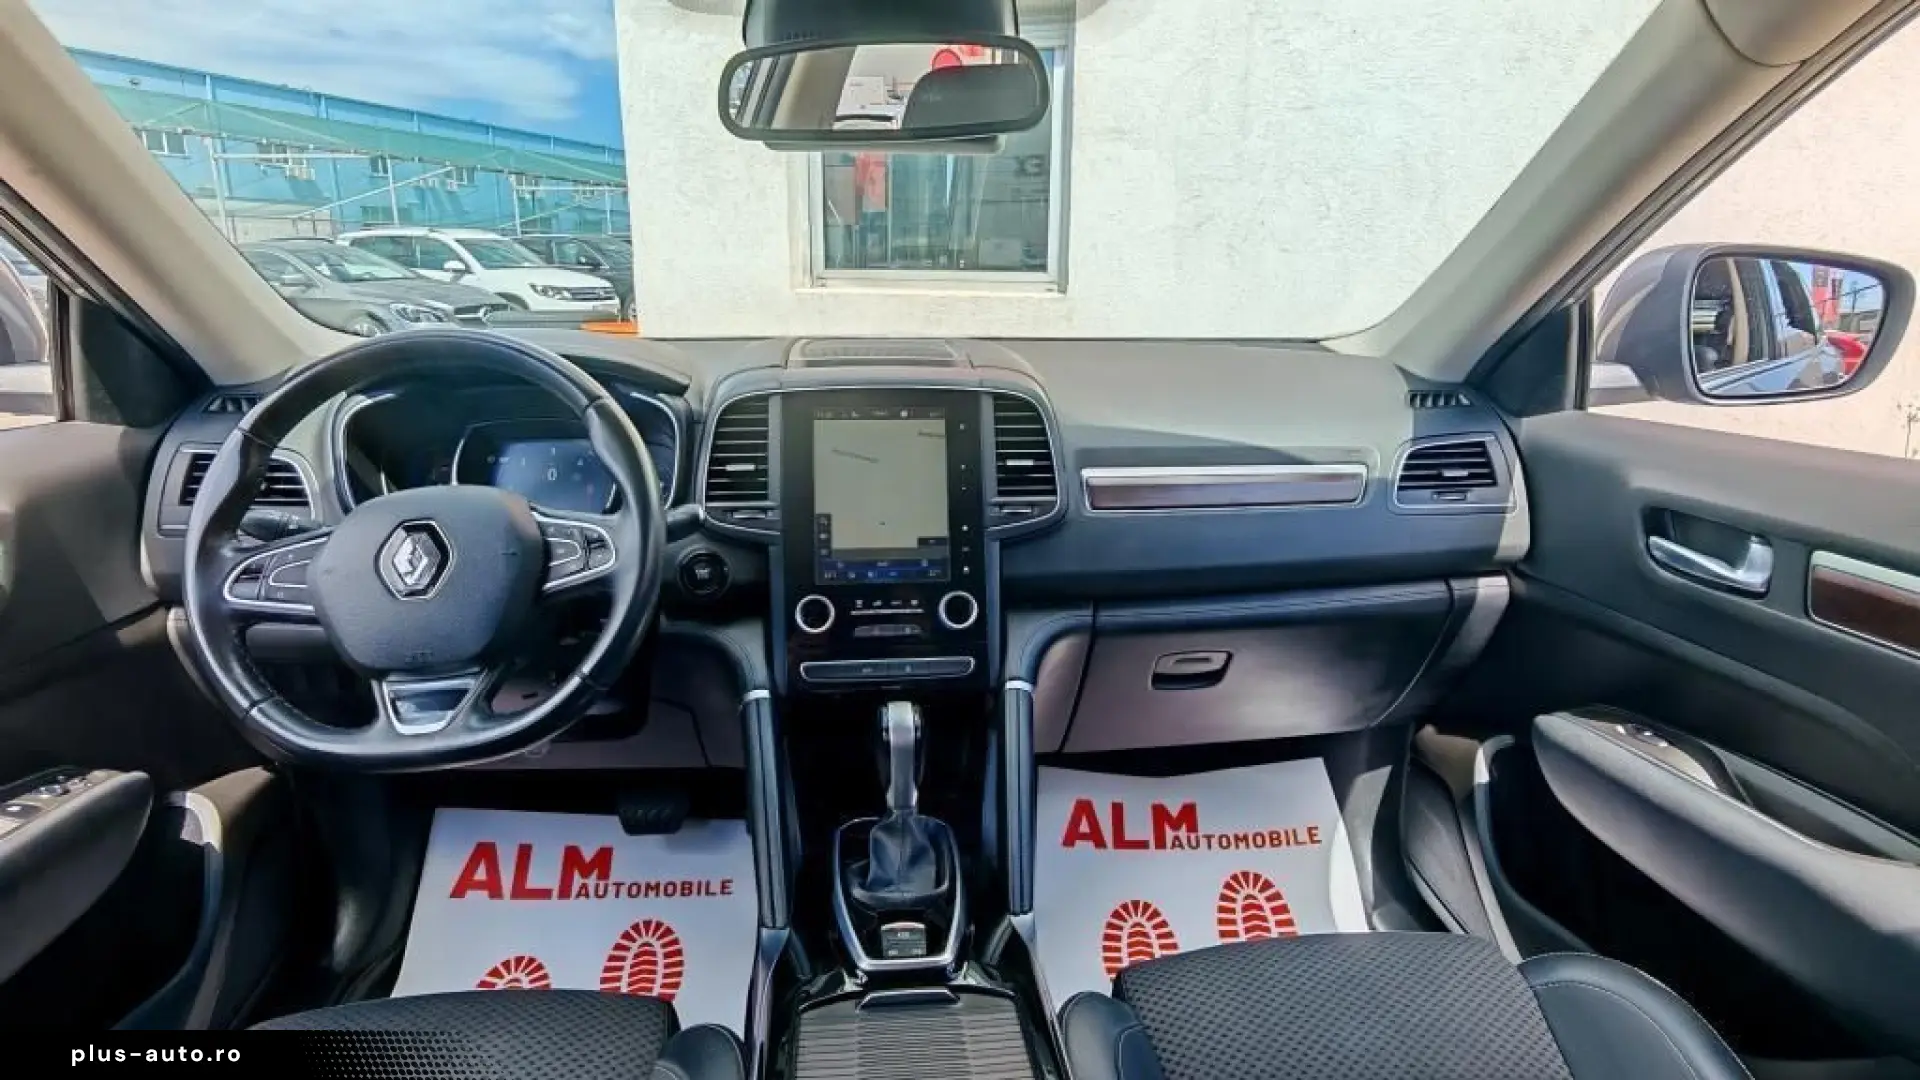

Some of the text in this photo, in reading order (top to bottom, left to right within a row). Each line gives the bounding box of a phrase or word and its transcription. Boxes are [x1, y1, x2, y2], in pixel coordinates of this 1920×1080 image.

[1061, 798, 1322, 850] ALM AUTOMOBILE
[449, 841, 734, 900] ALM AUTOMOBILE
